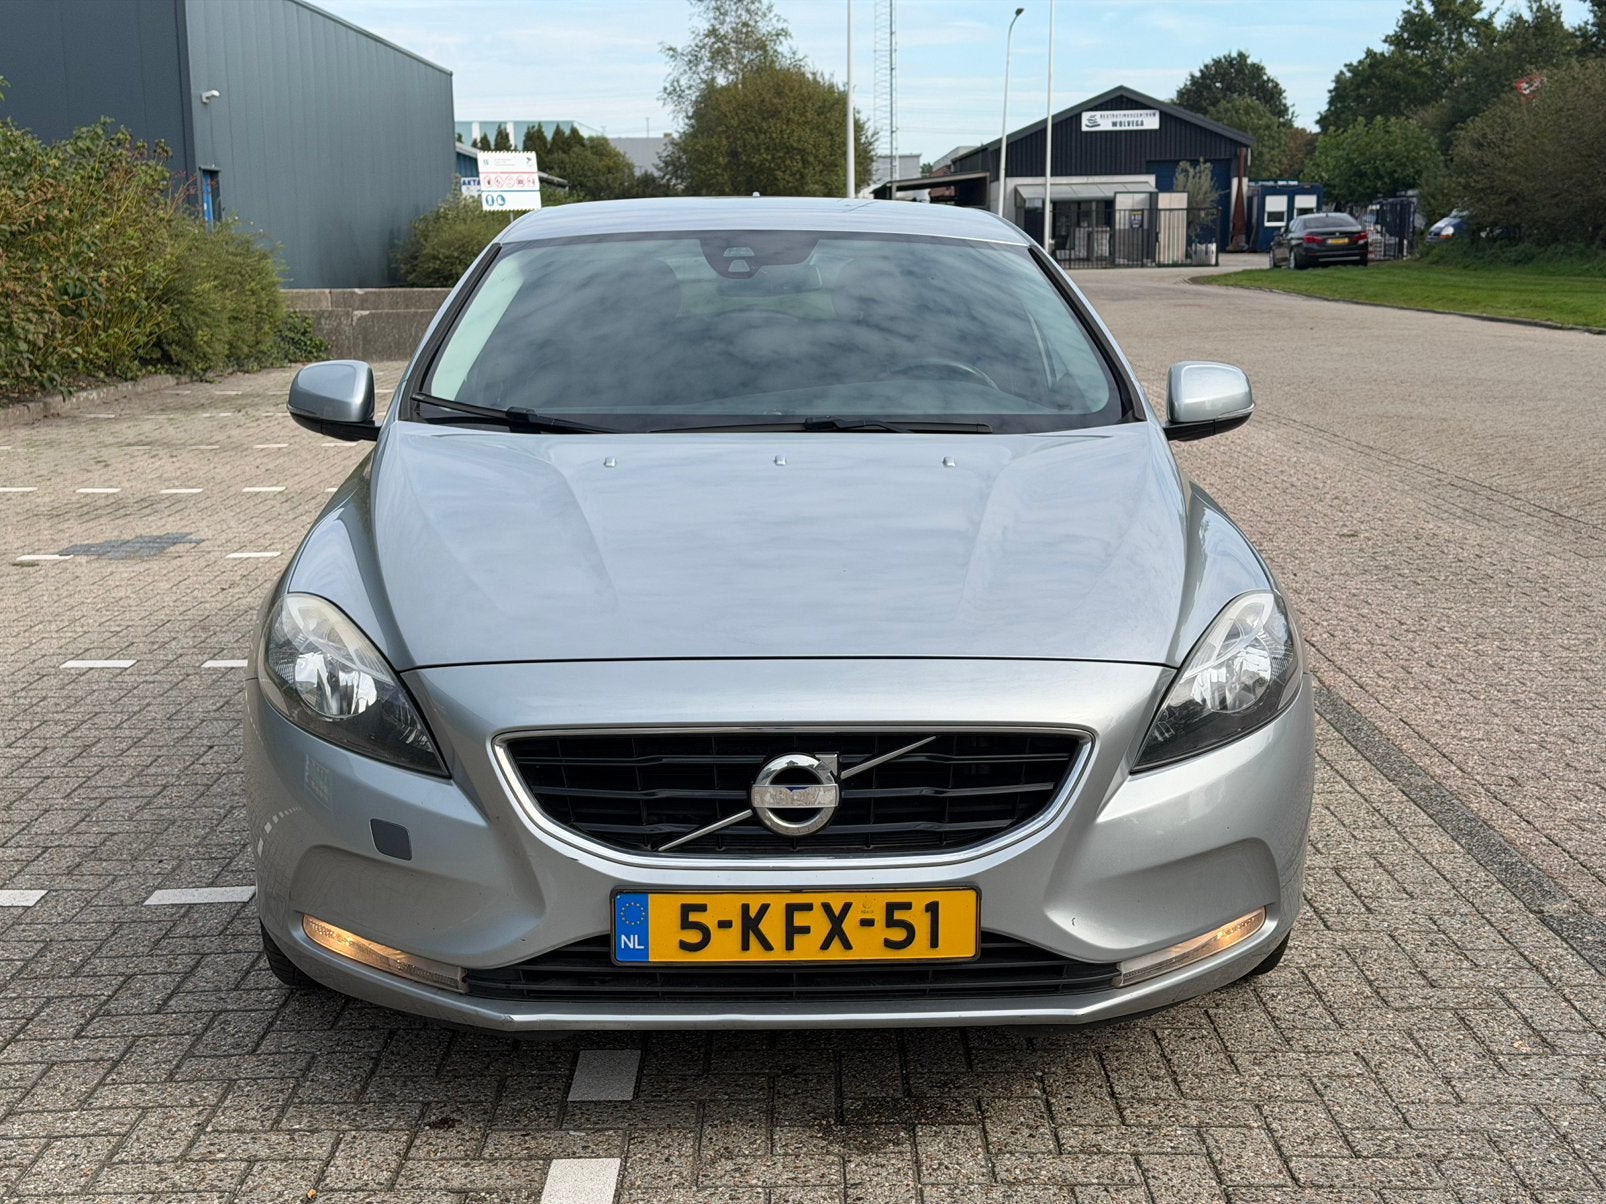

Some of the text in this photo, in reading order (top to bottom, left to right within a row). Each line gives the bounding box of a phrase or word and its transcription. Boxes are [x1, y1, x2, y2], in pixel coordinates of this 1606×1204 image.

[1112, 120, 1144, 128] WOLVEGA
[678, 900, 940, 953] 5-KFX-51
[620, 934, 645, 950] NL
